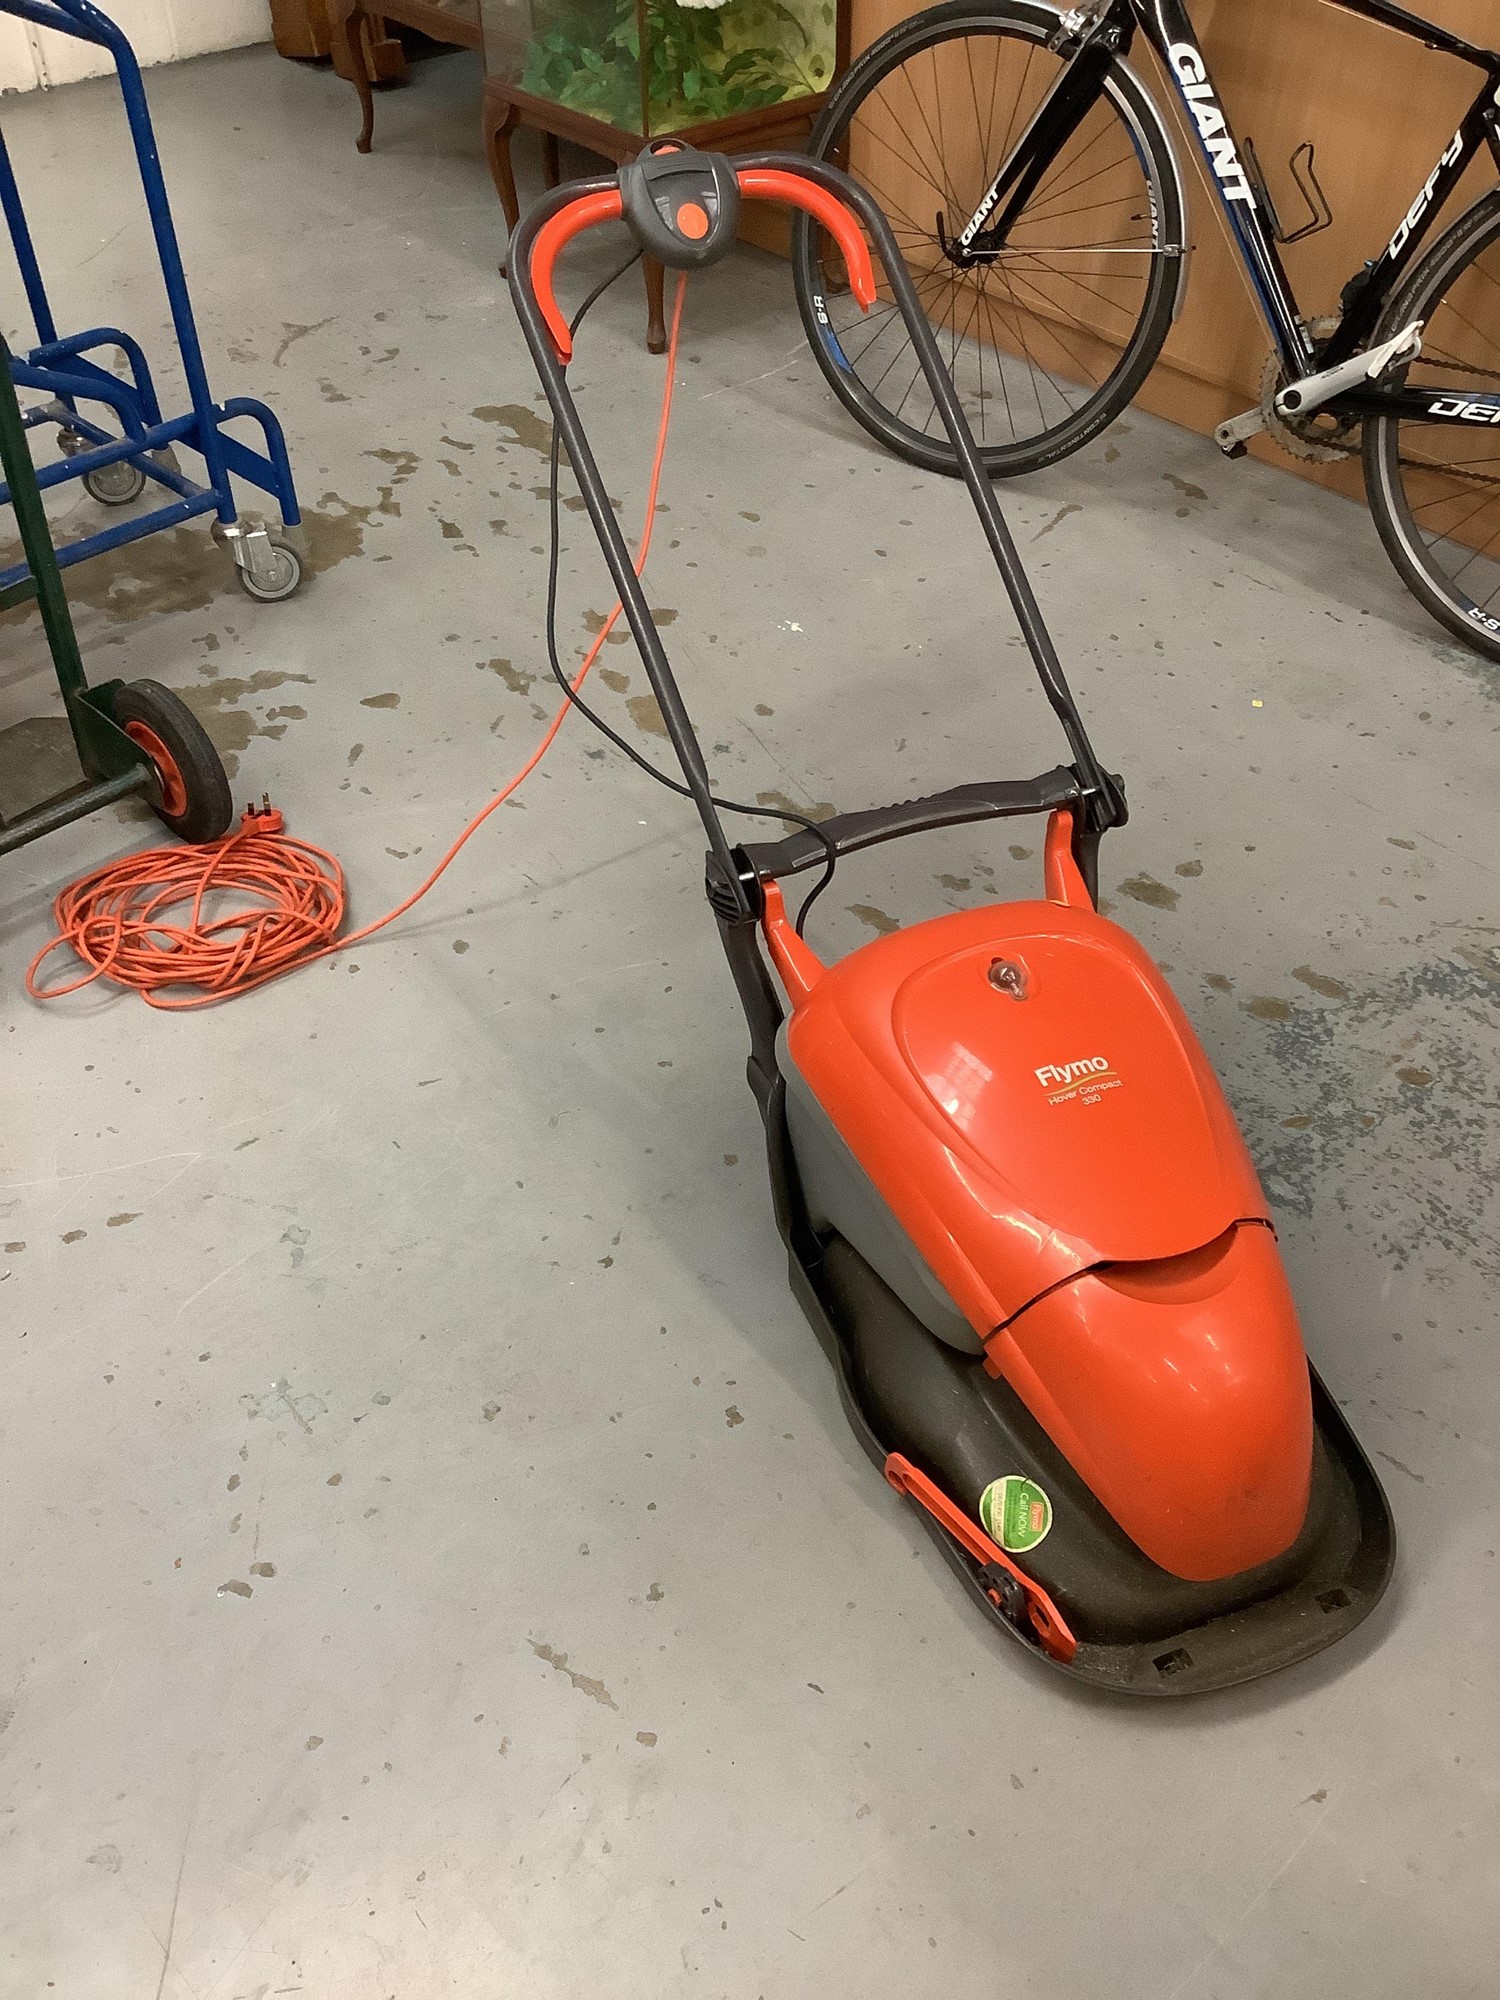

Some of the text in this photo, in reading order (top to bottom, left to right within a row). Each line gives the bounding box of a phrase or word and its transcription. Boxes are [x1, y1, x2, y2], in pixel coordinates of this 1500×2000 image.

[1169, 43, 1257, 209] GIANT
[1389, 129, 1463, 260] DEFY
[961, 185, 999, 246] GIANT
[1045, 419, 1100, 459] CONTINENTAL
[1034, 1056, 1109, 1087] Flymo
[1048, 1079, 1123, 1106] Hover Compact
[1081, 1094, 1102, 1105] 330
[1017, 1492, 1029, 1537] Call NOW
[1031, 1503, 1042, 1530] Flymo
